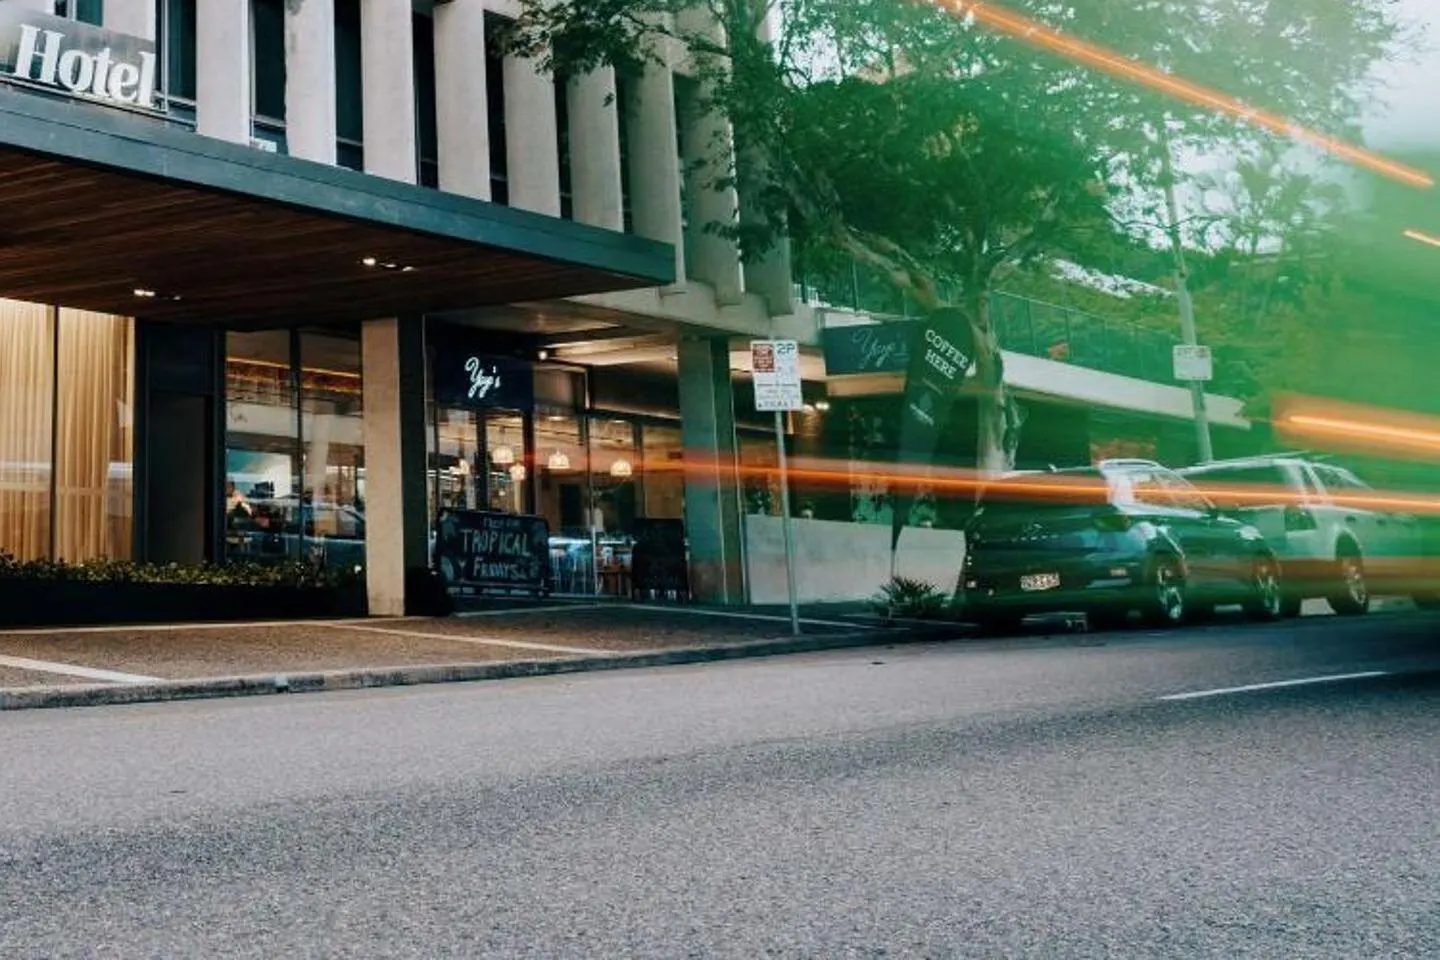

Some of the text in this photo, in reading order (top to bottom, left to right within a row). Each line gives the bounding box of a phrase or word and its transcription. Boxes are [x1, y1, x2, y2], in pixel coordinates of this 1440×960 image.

[13, 23, 156, 109] Hotel
[925, 329, 969, 369] COFFEE
[925, 349, 957, 380] HERE
[460, 528, 530, 557] TROPICAL
